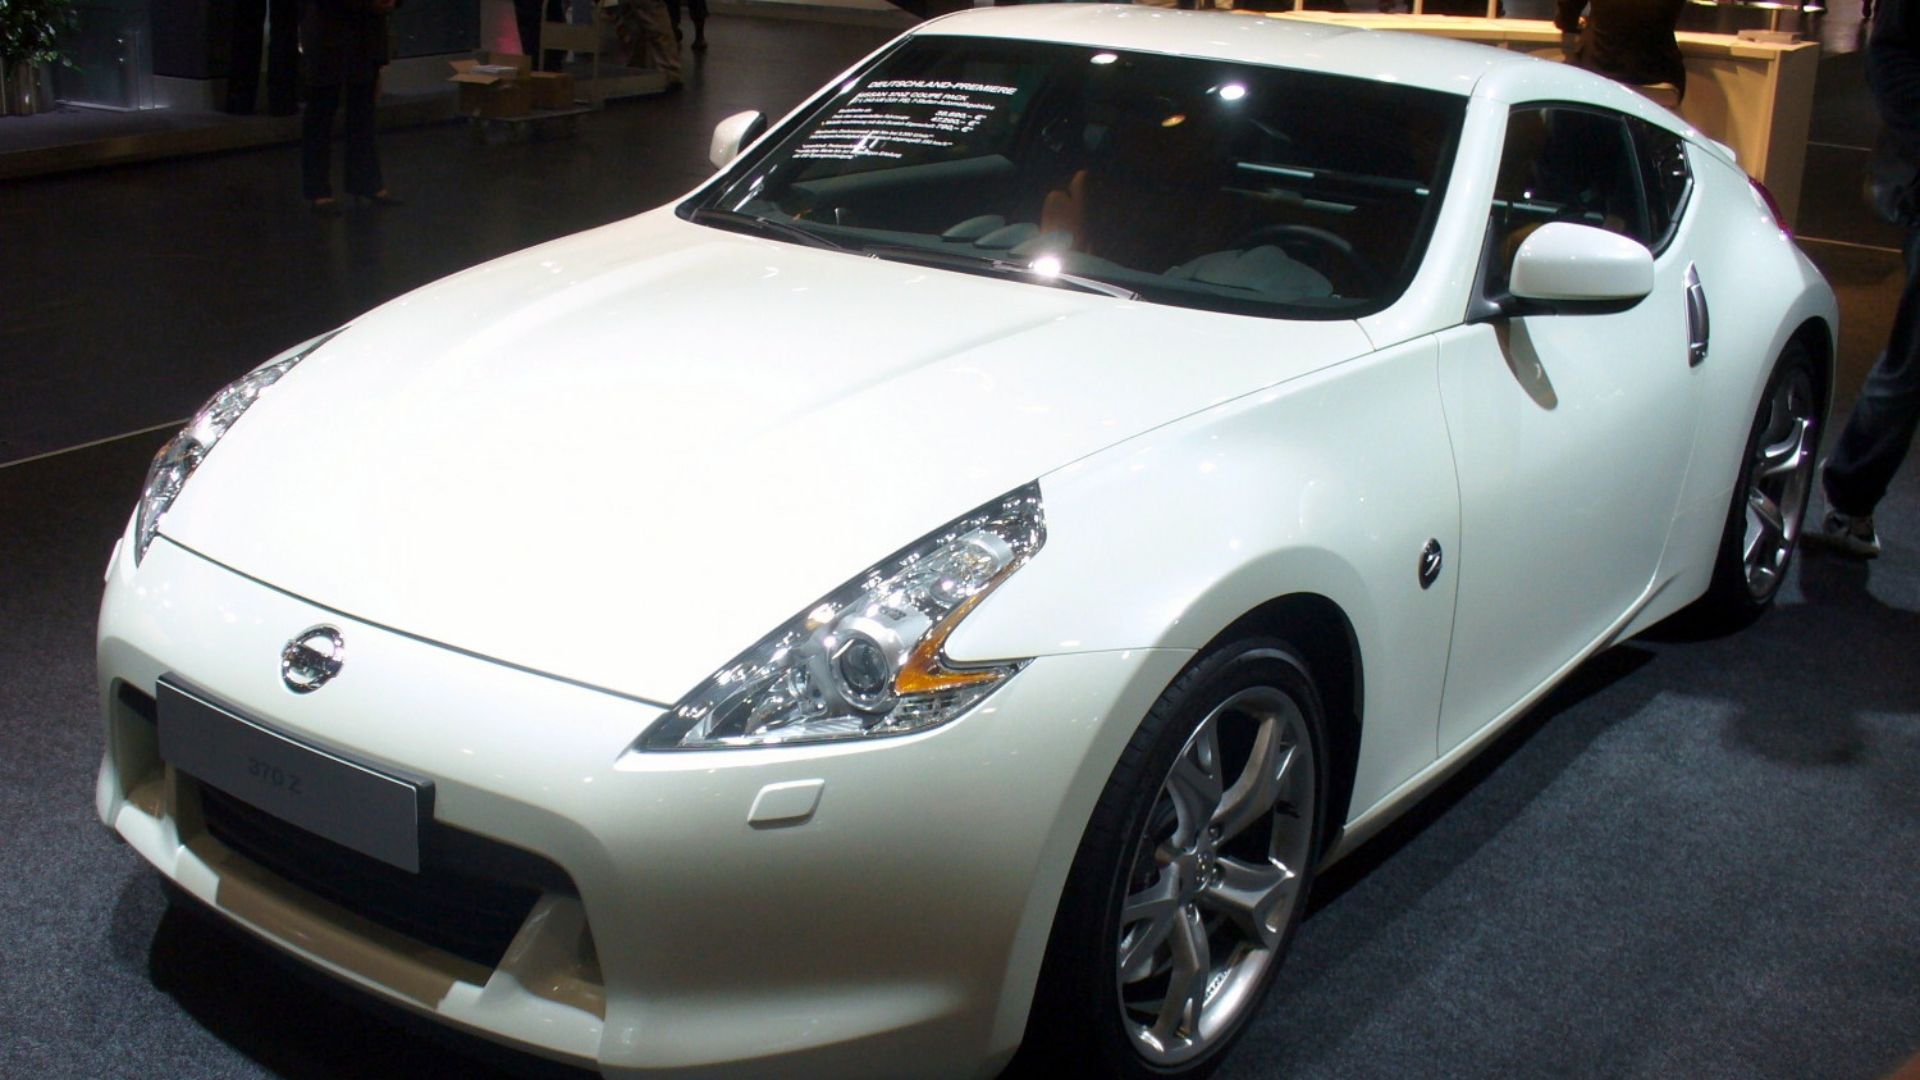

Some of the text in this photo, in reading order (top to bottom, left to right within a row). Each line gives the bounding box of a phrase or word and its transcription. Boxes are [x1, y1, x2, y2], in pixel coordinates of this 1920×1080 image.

[867, 80, 1018, 96] DEUTSCHLAND-PREMIERE
[248, 758, 303, 795] 370 Z
